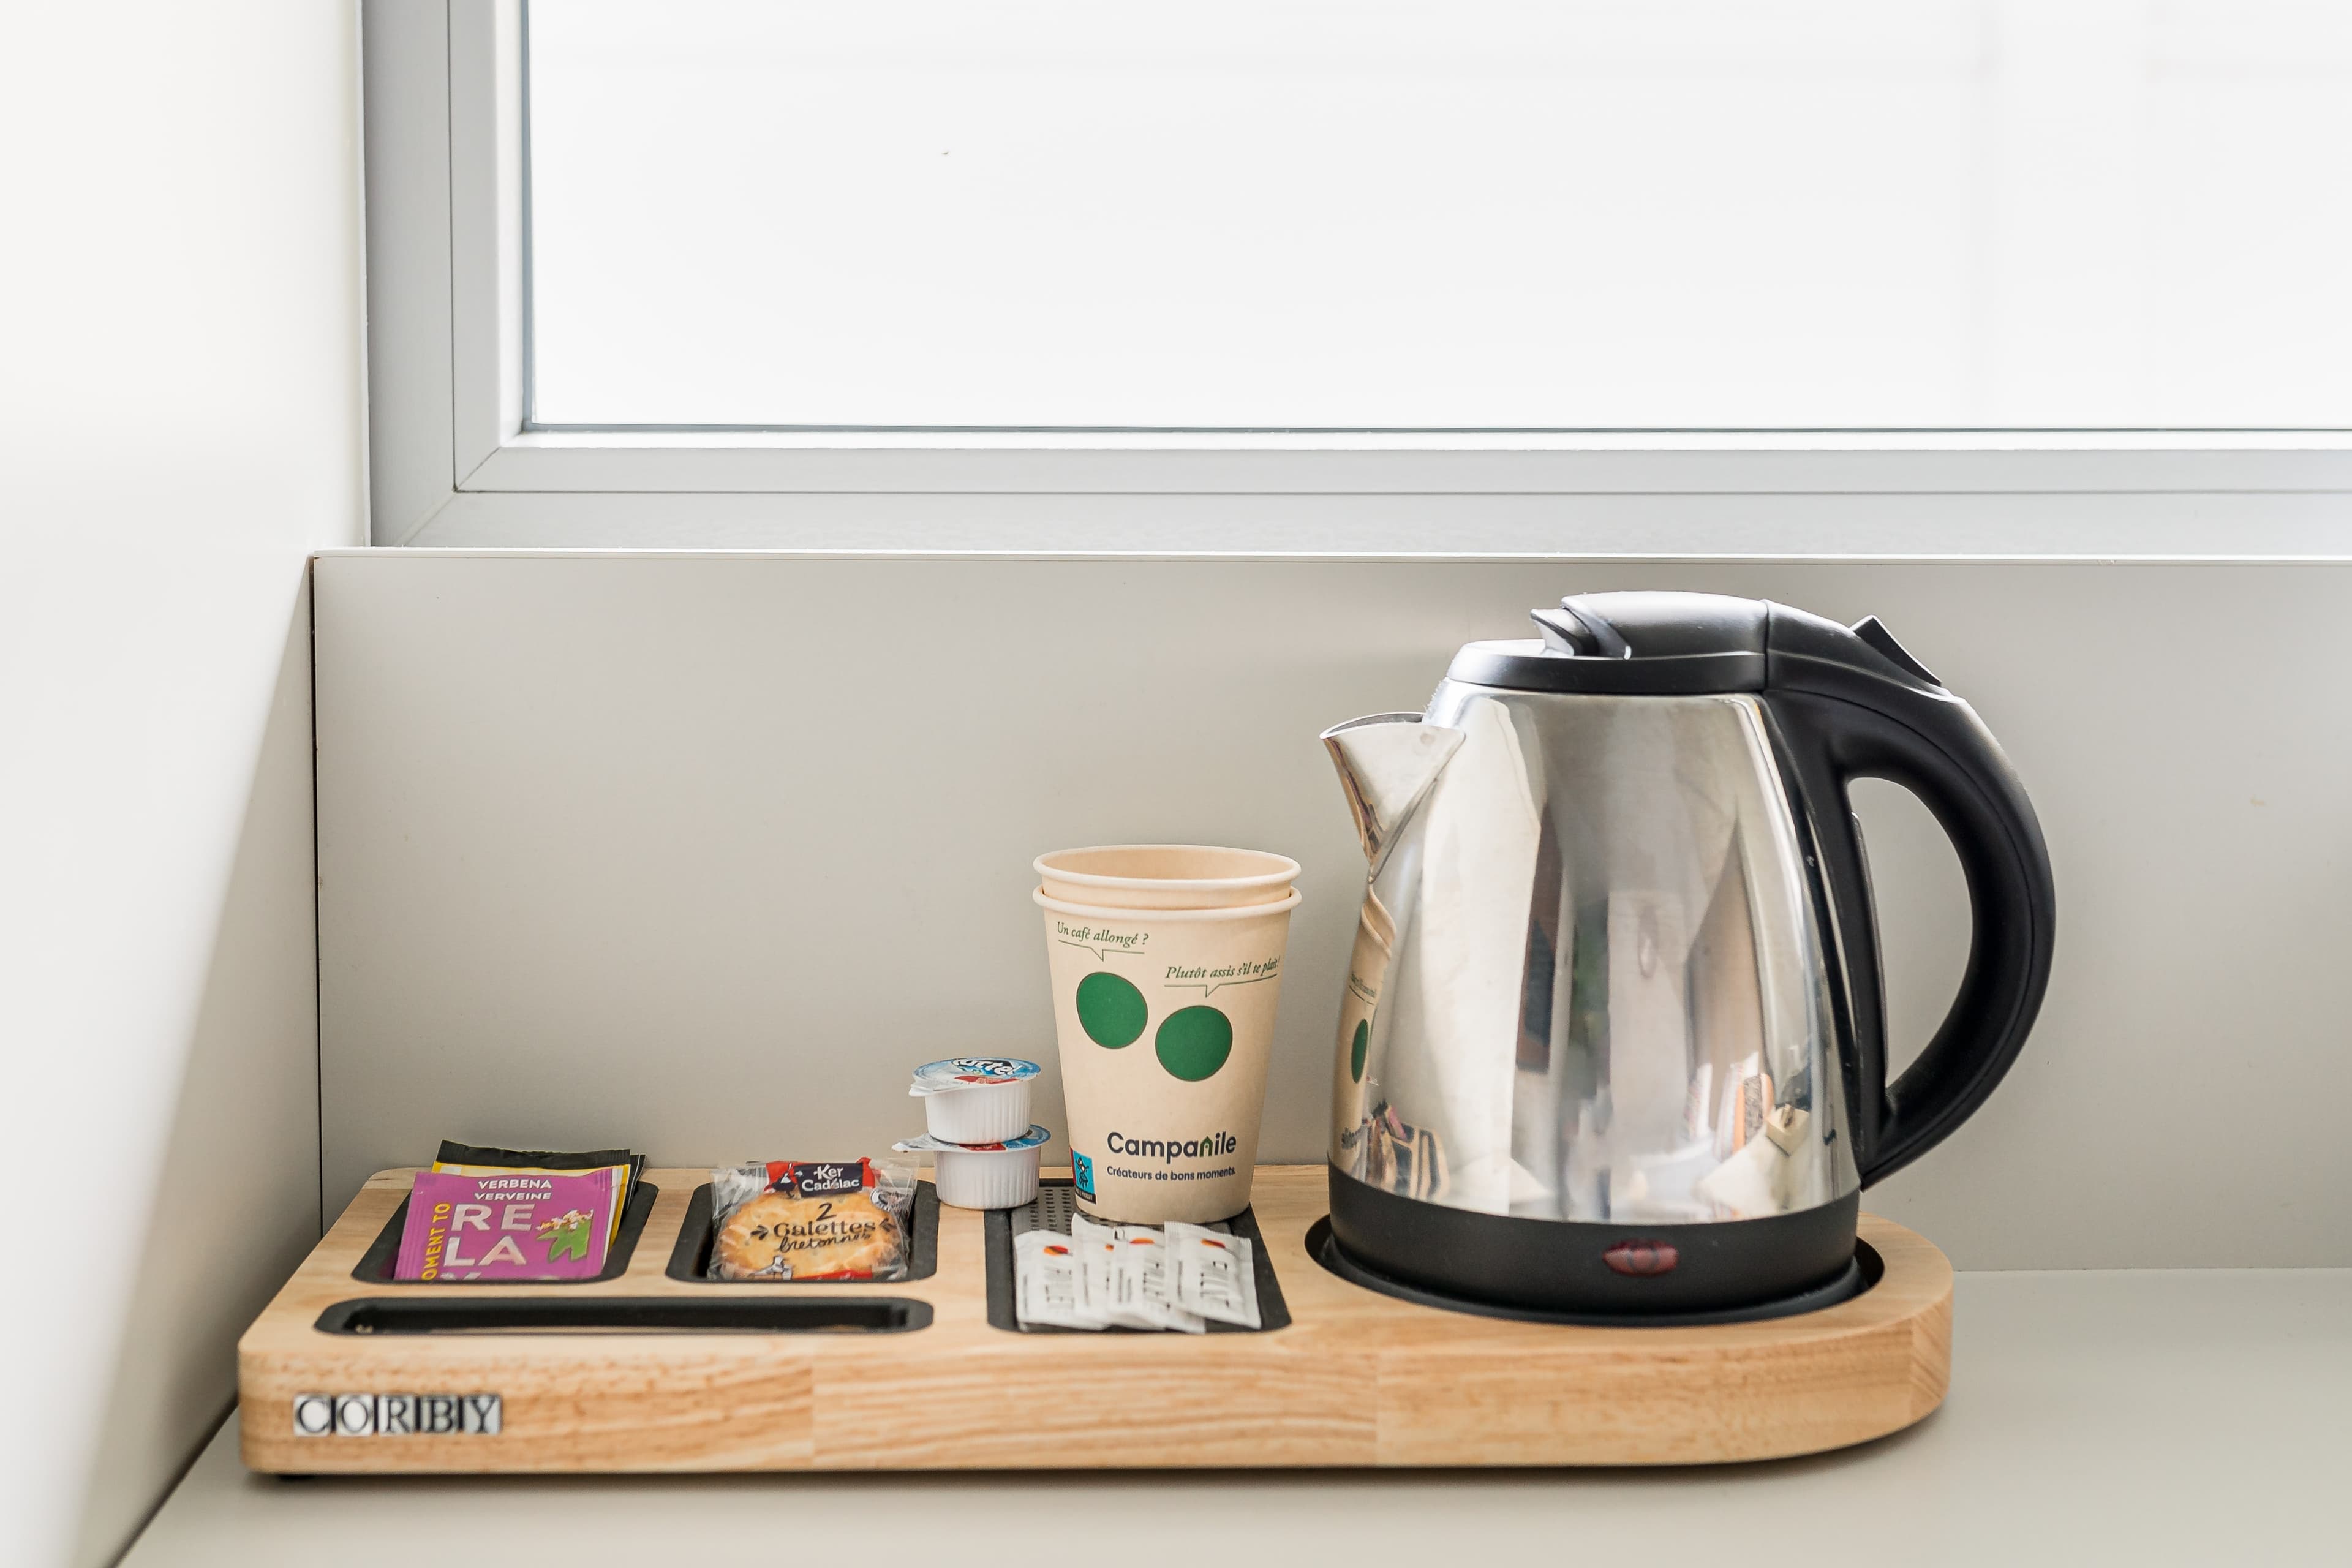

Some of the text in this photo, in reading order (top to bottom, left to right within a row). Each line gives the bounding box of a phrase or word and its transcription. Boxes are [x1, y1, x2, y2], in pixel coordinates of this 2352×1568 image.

[1057, 921, 1149, 948] Un café allongé ?
[1165, 966, 1207, 979] Plutôt
[1210, 965, 1235, 978] assis
[1253, 964, 1261, 974] te
[1107, 1131, 1237, 1164] Campanile
[814, 1164, 843, 1180] Ker
[1107, 1166, 1153, 1180] Créateurs
[1155, 1170, 1169, 1180] de
[1170, 1170, 1195, 1181] bons
[478, 1179, 552, 1189] VERBENA
[801, 1177, 861, 1193] Cadélac
[474, 1192, 552, 1200] VERVEINE
[451, 1203, 535, 1231] RE
[816, 1203, 837, 1222] 2
[774, 1219, 876, 1238] Galettes
[421, 1202, 451, 1281] OMENT TO
[443, 1235, 527, 1267] LA
[298, 1399, 496, 1434] CORBY
